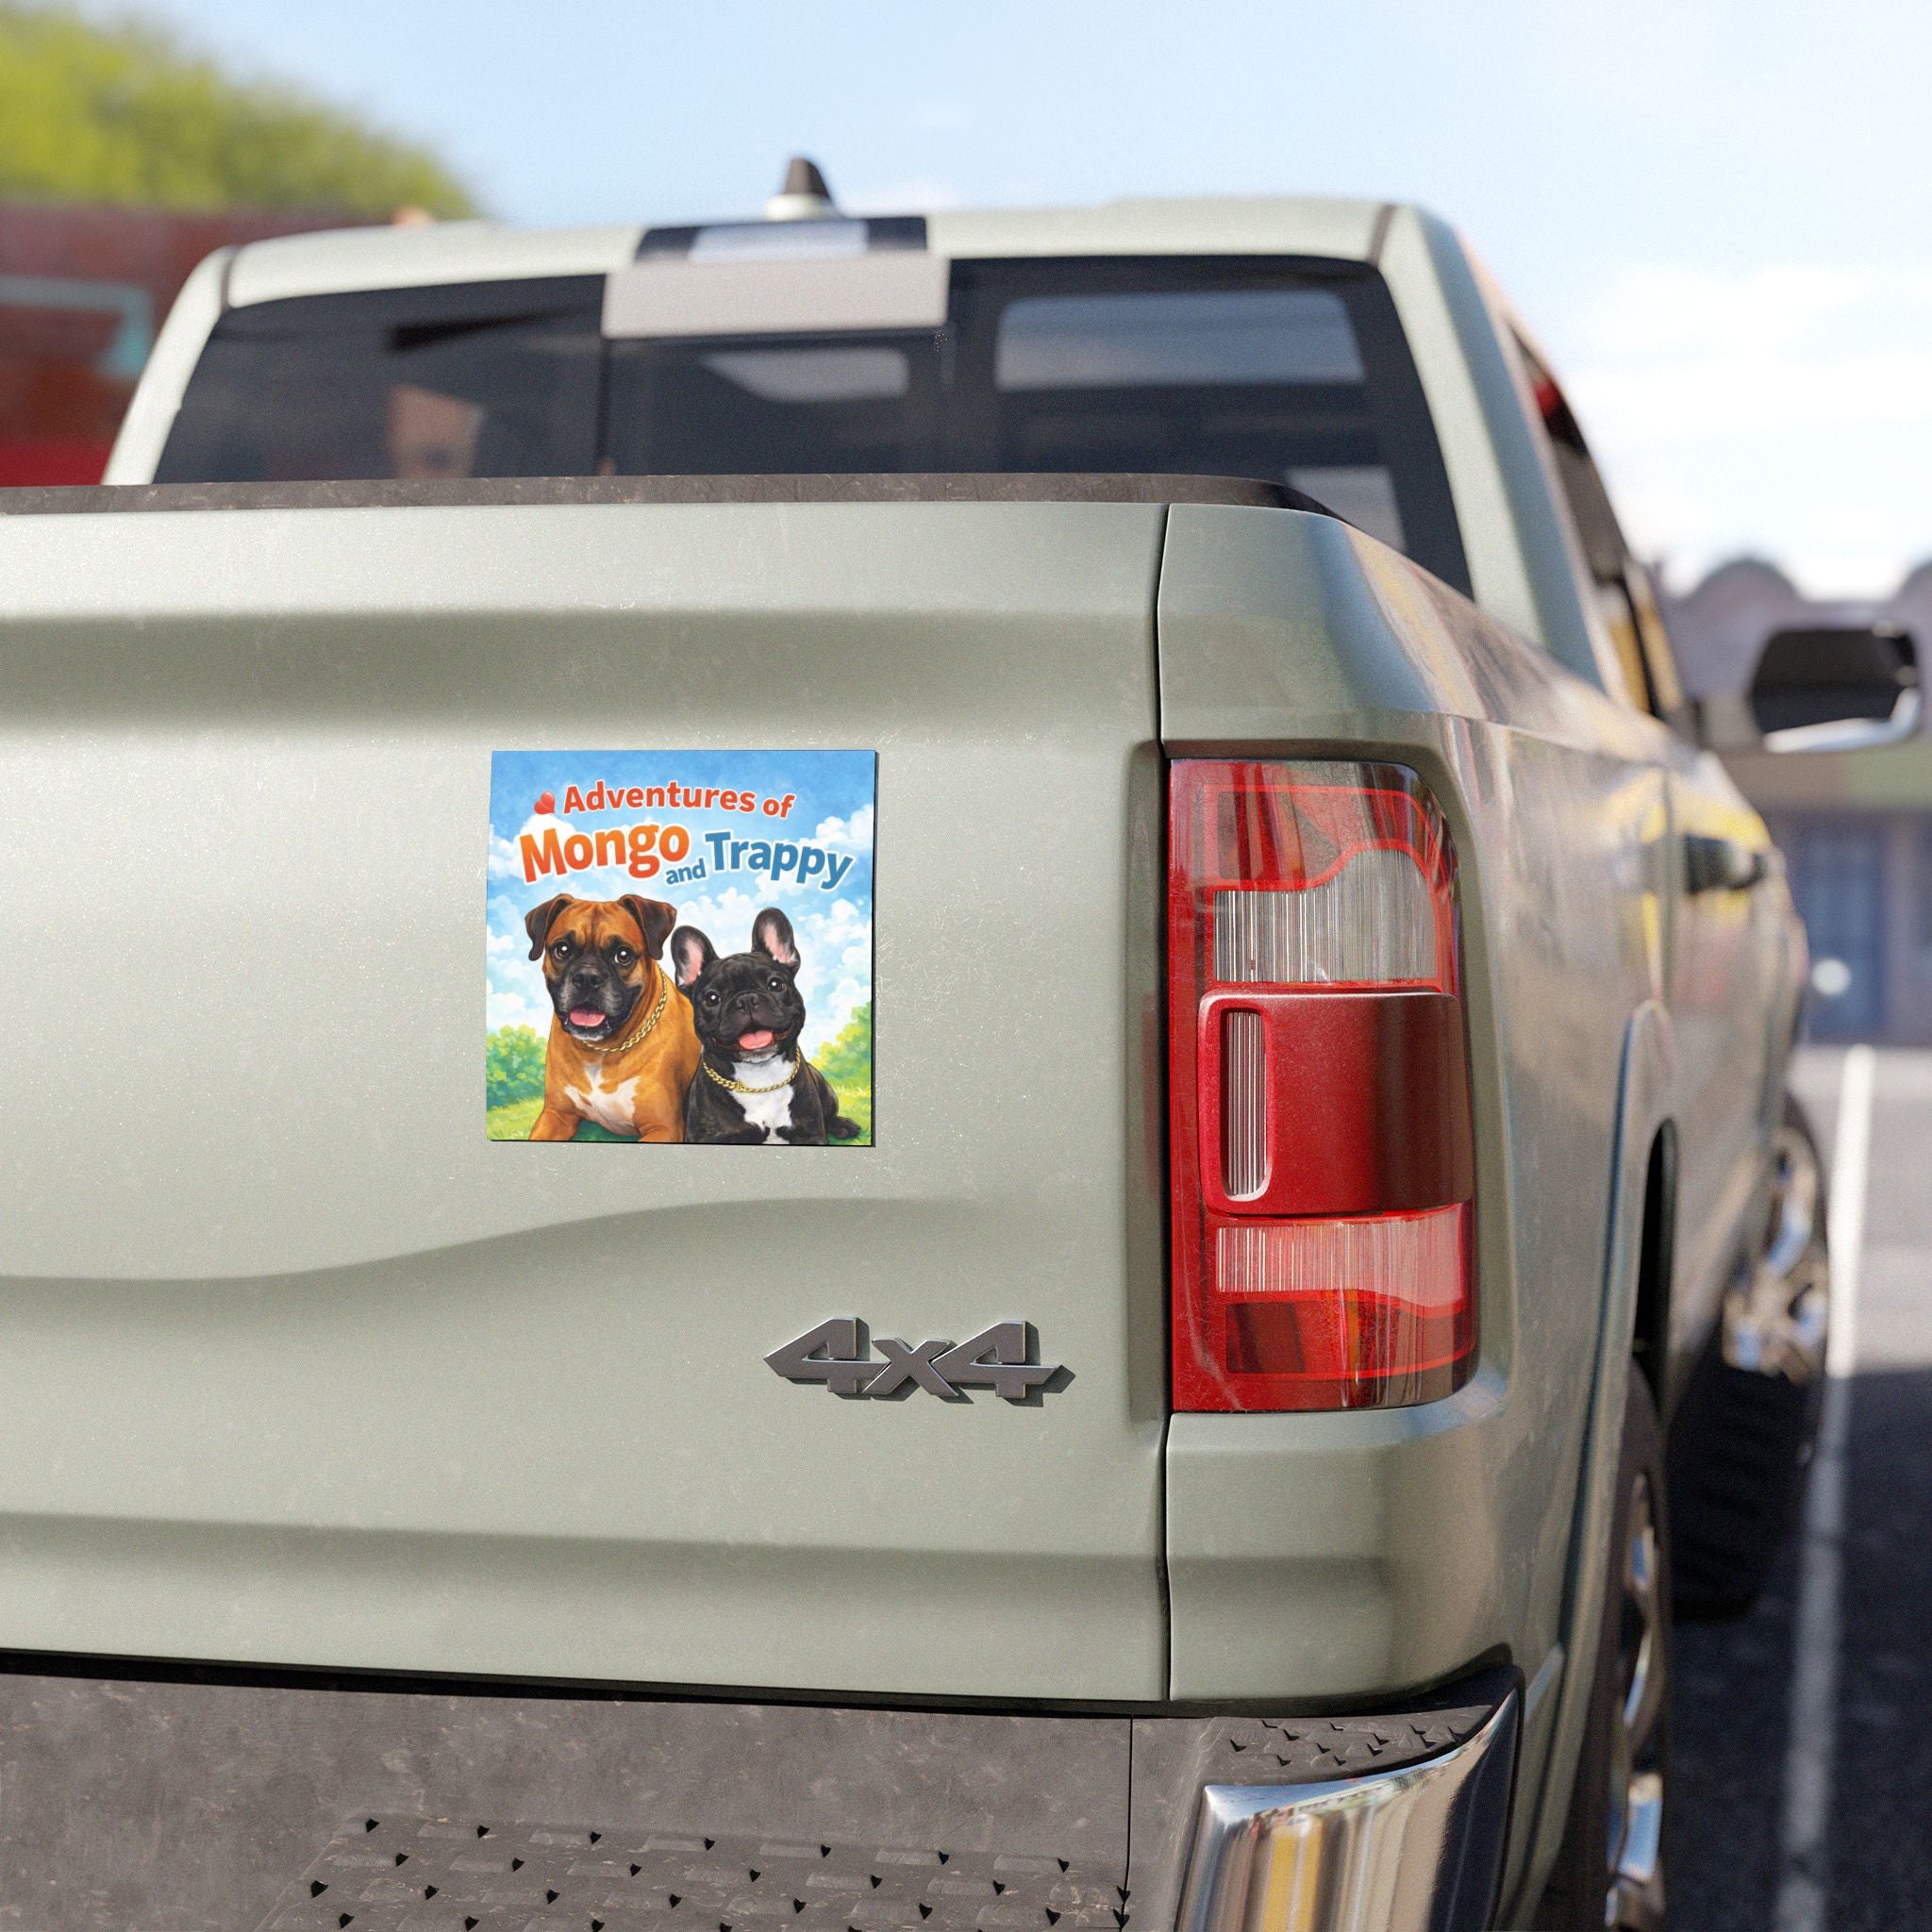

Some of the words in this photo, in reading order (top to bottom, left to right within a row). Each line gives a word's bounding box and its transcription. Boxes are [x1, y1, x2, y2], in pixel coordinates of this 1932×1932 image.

[563, 780, 756, 814] Adventures
[762, 793, 795, 818] of
[519, 823, 690, 883] Mongo
[665, 859, 707, 885] and
[705, 831, 853, 890] Trappy
[763, 1317, 1062, 1398] 4x4
